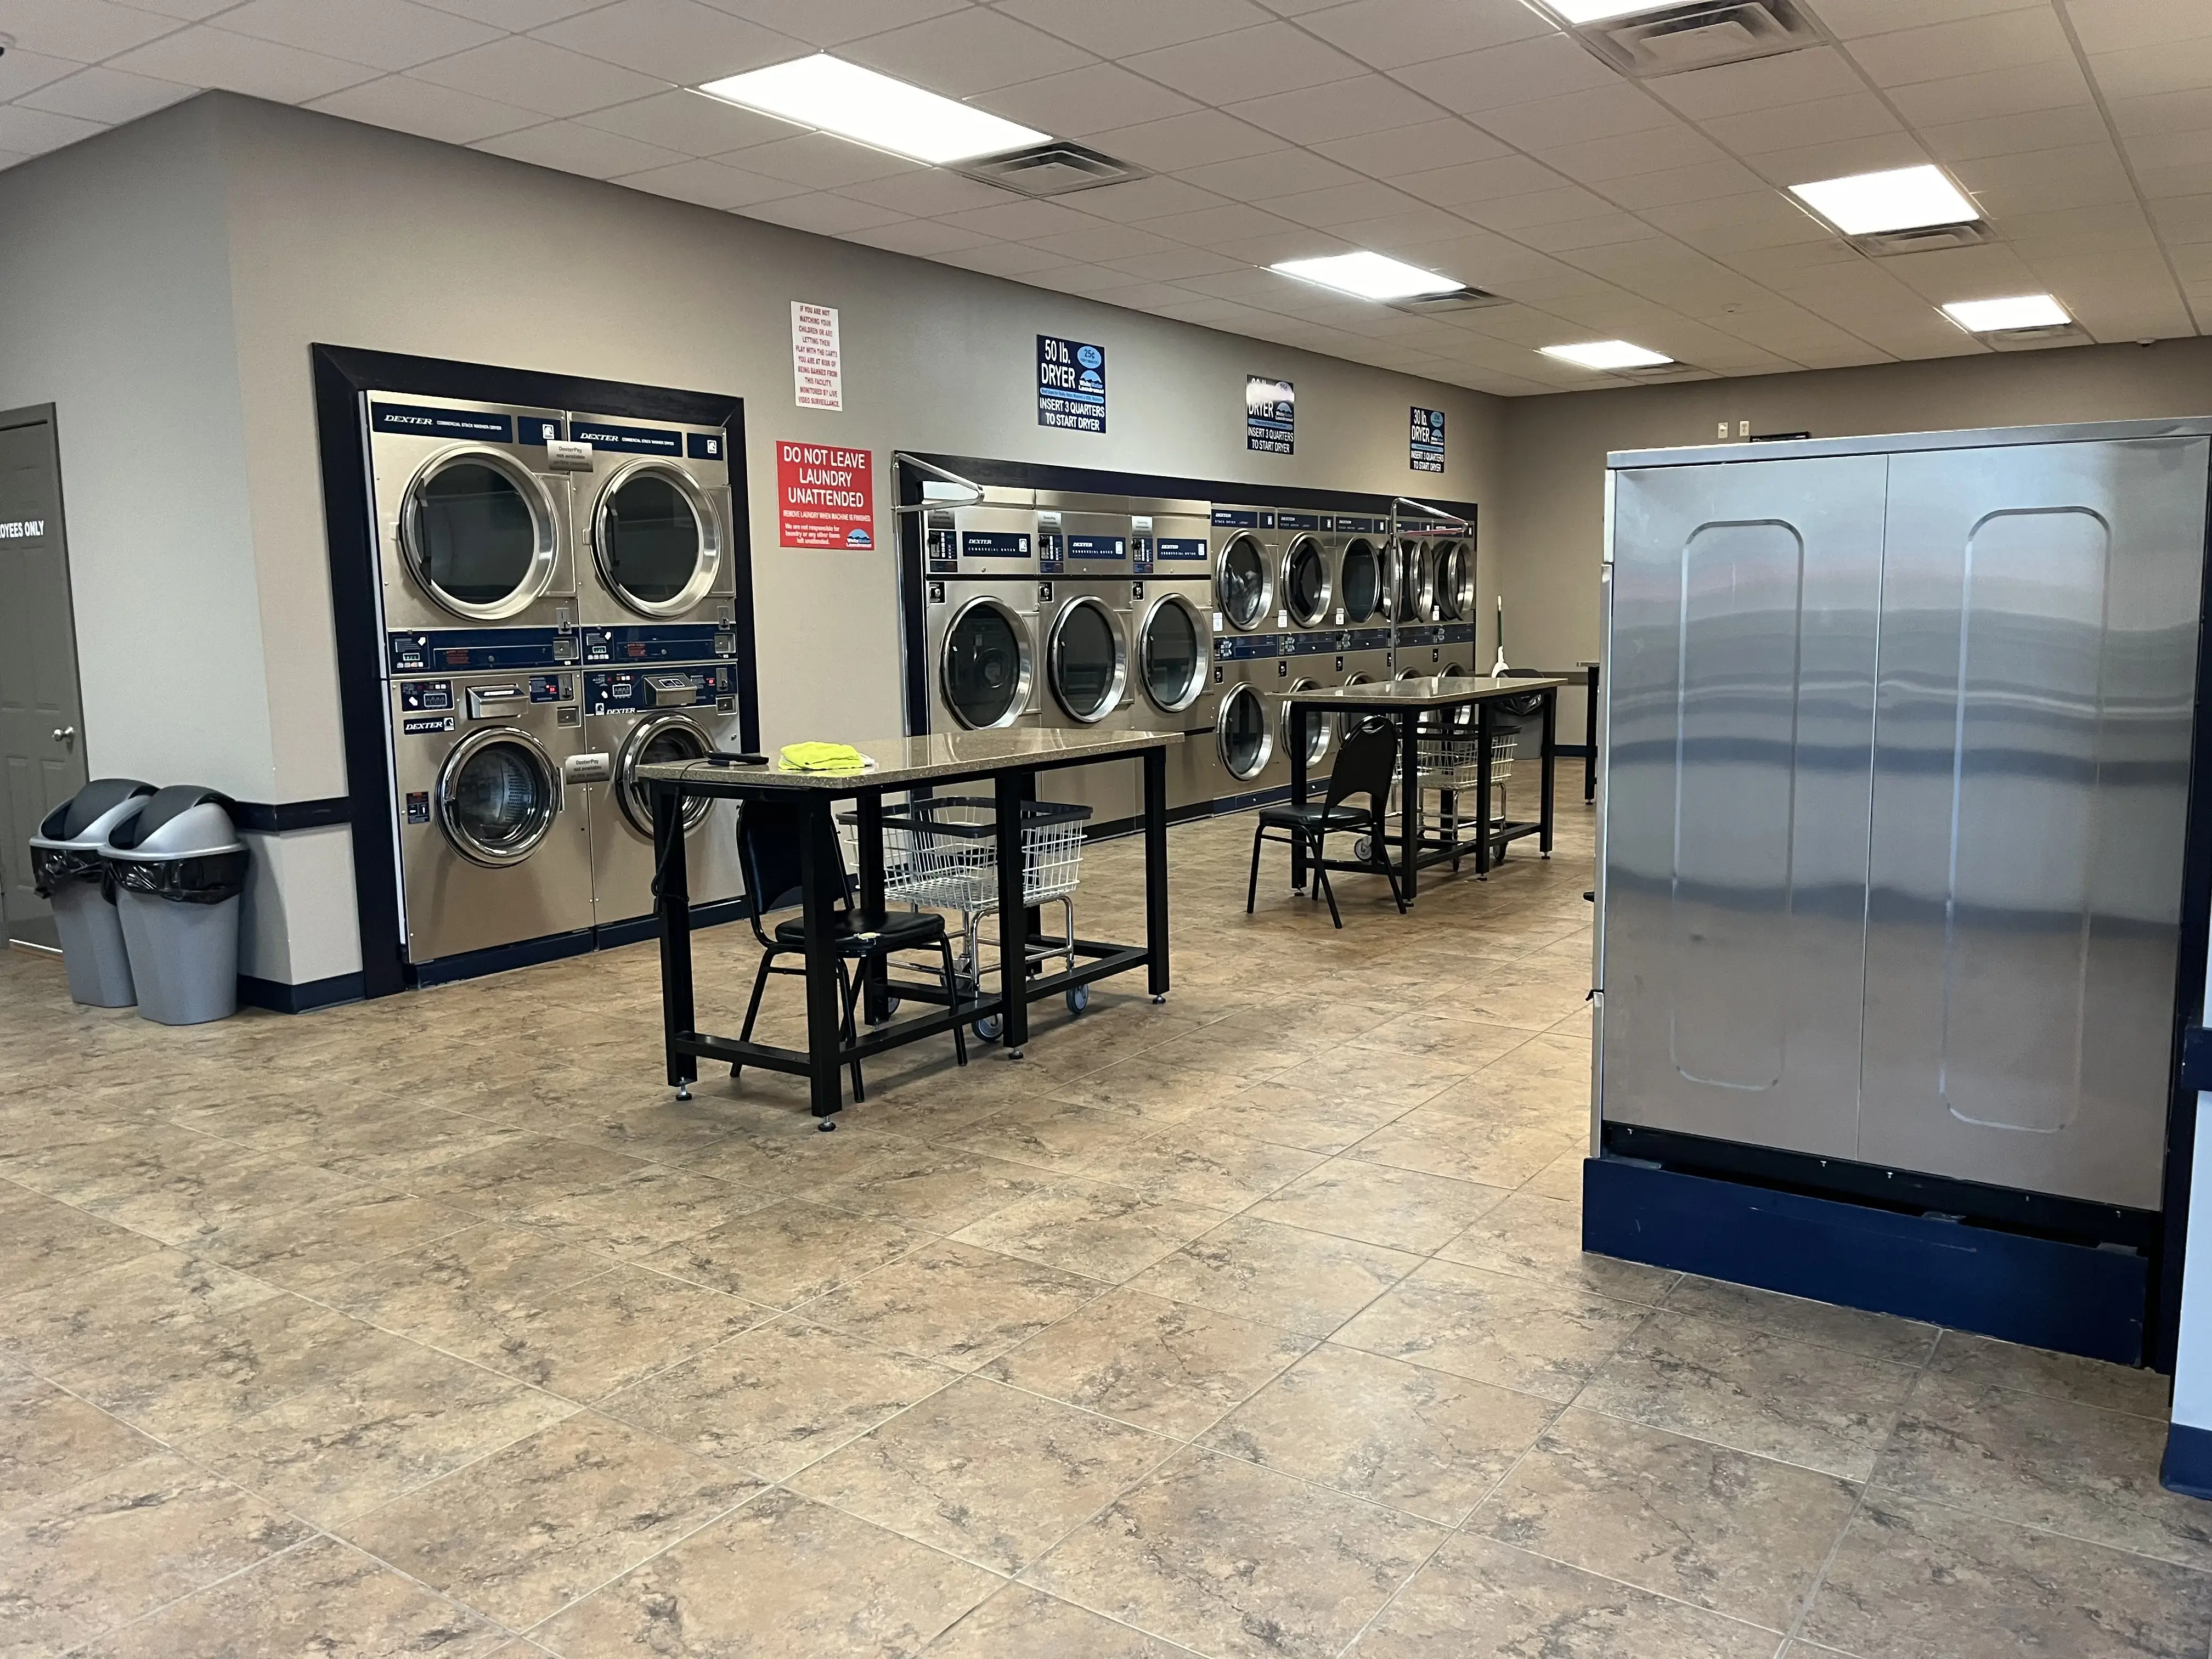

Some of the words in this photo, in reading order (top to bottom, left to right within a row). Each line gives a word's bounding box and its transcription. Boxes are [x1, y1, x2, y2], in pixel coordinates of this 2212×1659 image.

[799, 315, 820, 325] WATCHING
[799, 325, 817, 334] CHILDREN
[803, 336, 819, 345] LETTING
[1045, 339, 1057, 362] 50
[1059, 341, 1071, 364] lb.
[1084, 349, 1095, 359] 25¢
[1041, 363, 1075, 389] DRYER
[800, 386, 822, 394] MONITORED
[1040, 397, 1064, 411] INSERT
[1065, 401, 1069, 412] 3
[1070, 402, 1105, 418] QUARTERS
[1249, 401, 1273, 417] DRYER
[384, 415, 433, 425] DEXTER
[1046, 413, 1055, 425] TO
[1056, 414, 1077, 428] START
[1078, 417, 1100, 431] DRYER
[1414, 409, 1420, 425] 30
[580, 433, 618, 442] DEXTER
[1248, 426, 1265, 438] INSERT
[1266, 429, 1268, 438] 3
[1269, 430, 1294, 442] QUARTERS
[1412, 425, 1430, 443] DRYER
[1252, 439, 1259, 449] TO
[1259, 441, 1274, 451] START
[1275, 442, 1290, 453] DRYER
[783, 445, 802, 462] DO
[804, 448, 828, 465] NOT
[831, 450, 866, 469] LEAVE
[799, 467, 852, 487] LAUNDRY
[788, 487, 864, 507] UNATTENDED
[783, 510, 800, 518] REMOVE
[800, 511, 820, 519] LAUNDRY
[0, 522, 23, 538] OYEES
[24, 520, 44, 537] ONLY
[405, 721, 443, 730] DEXTER
